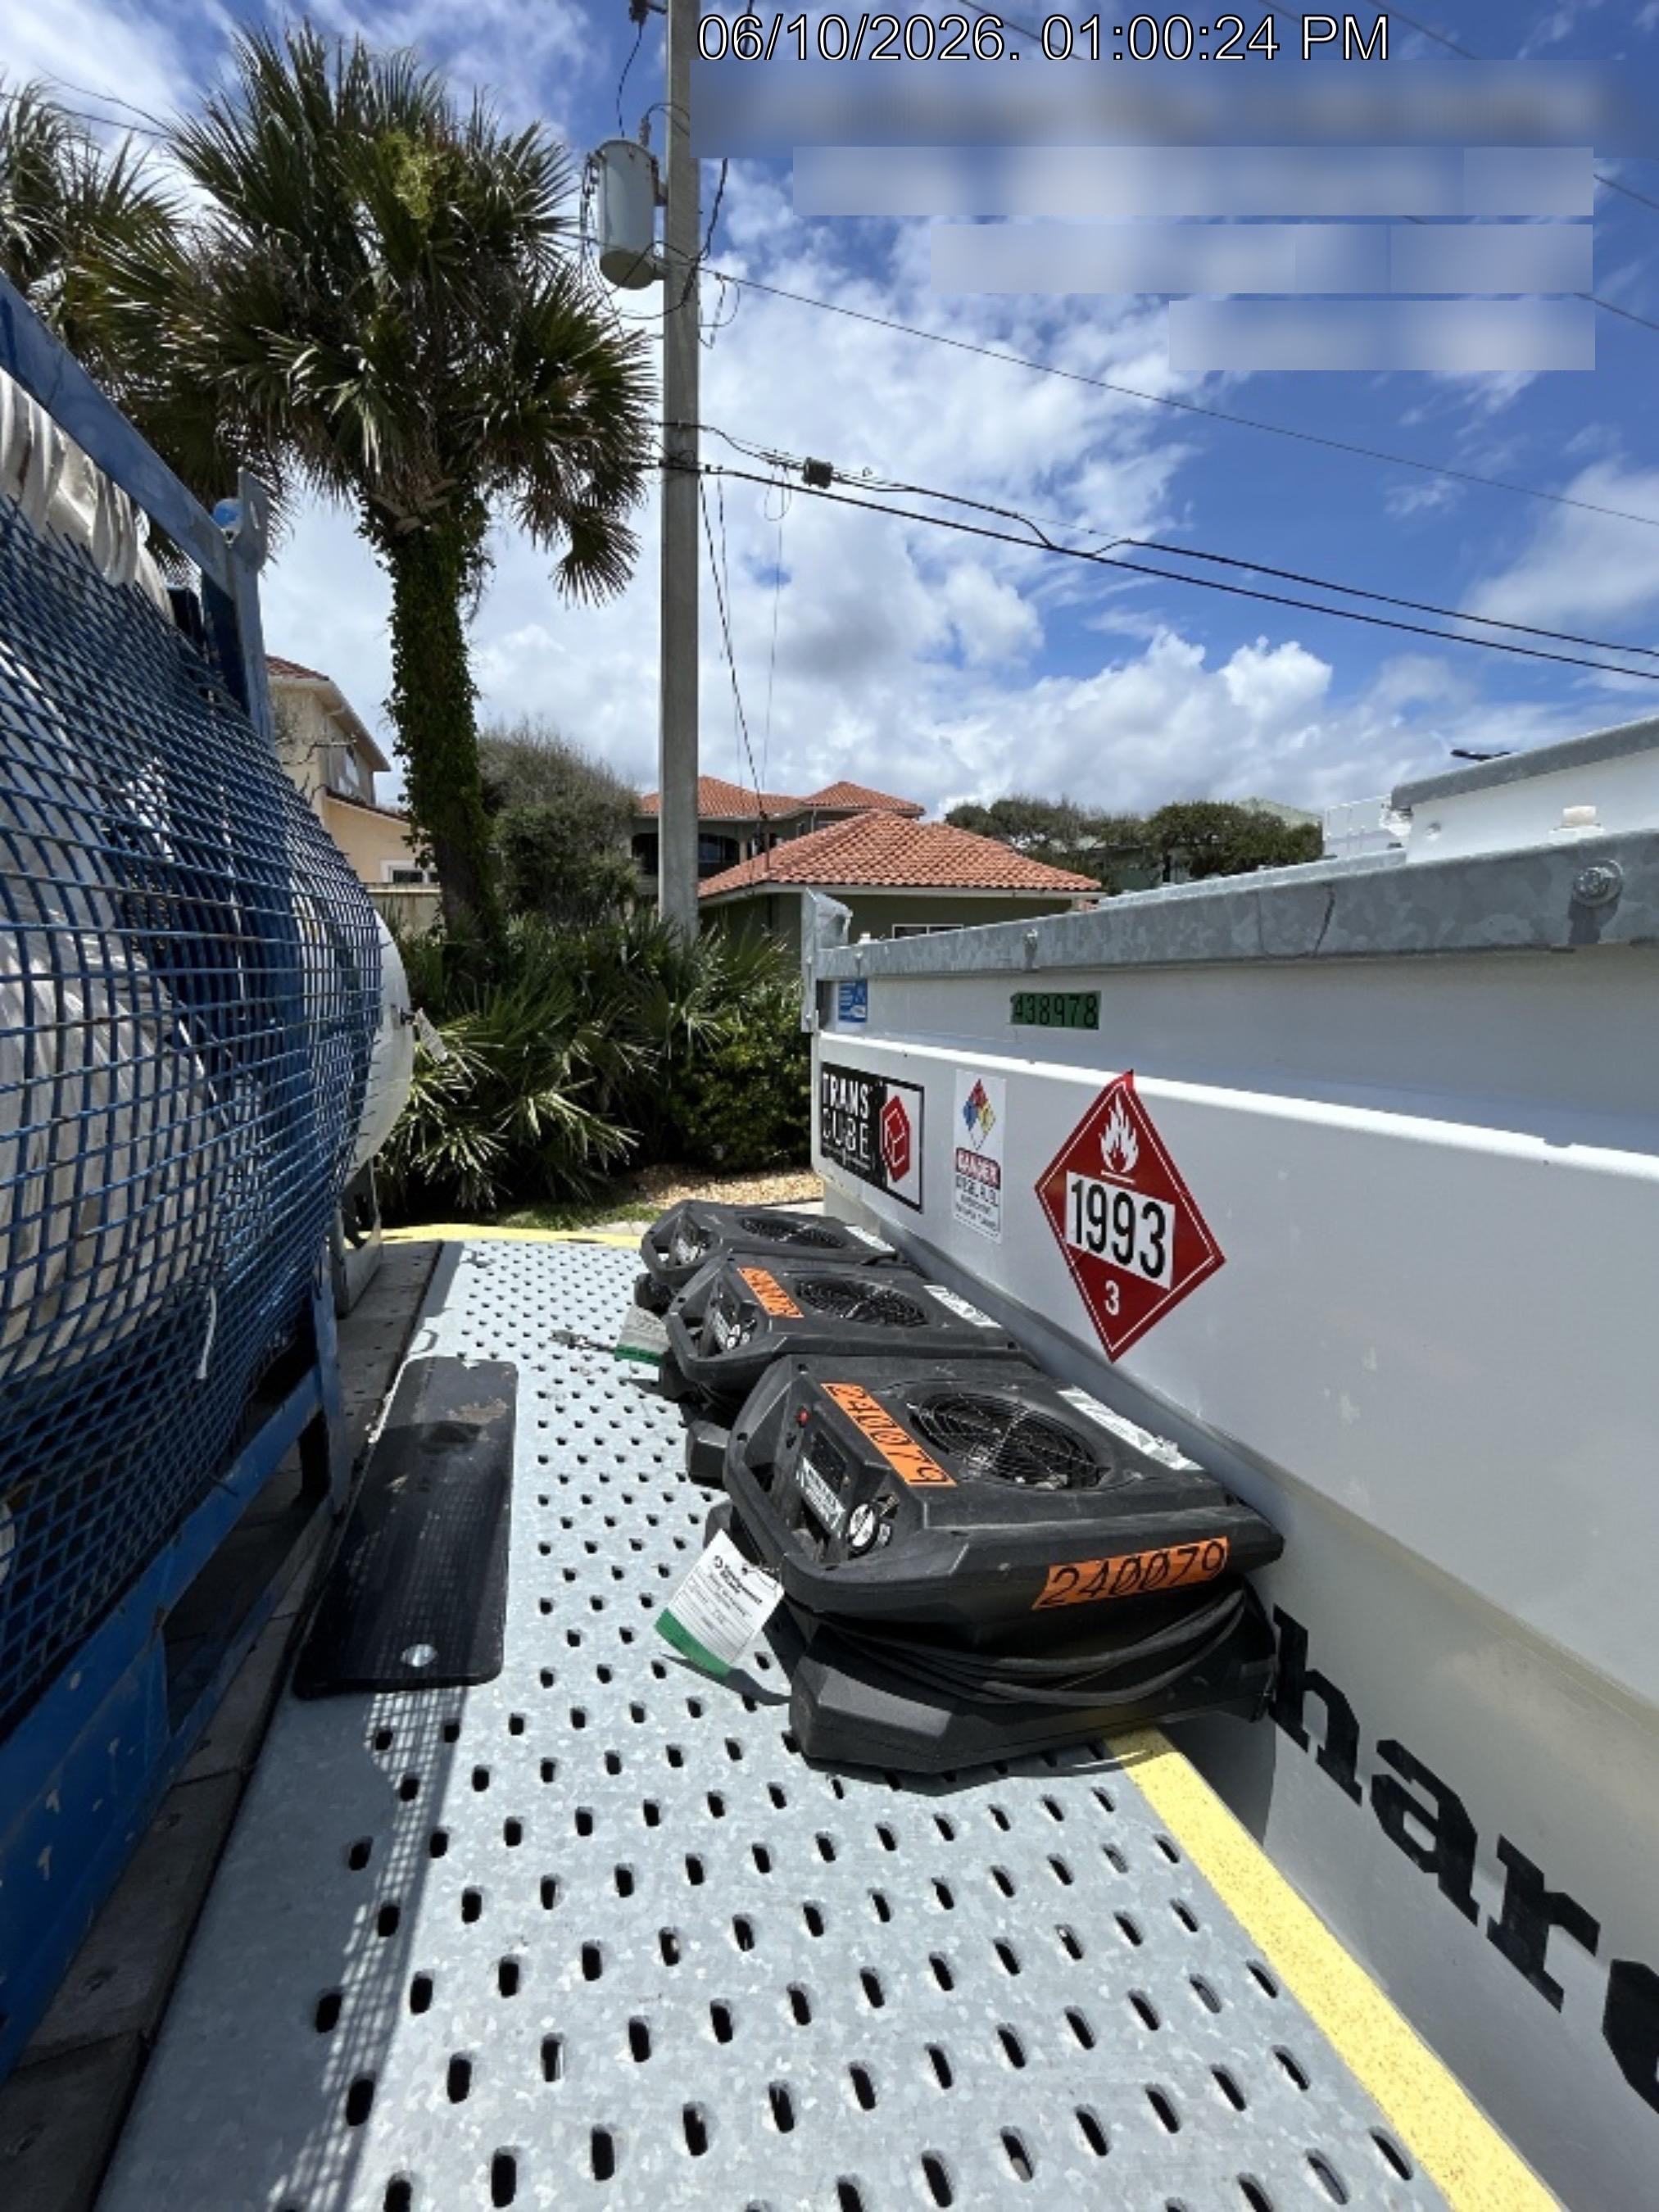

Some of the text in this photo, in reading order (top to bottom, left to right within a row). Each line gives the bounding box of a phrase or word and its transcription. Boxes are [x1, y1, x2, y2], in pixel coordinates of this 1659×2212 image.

[822, 1072, 869, 1119] TRANS
[1070, 1179, 1167, 1278] 1993
[1104, 1279, 1120, 1317] 3
